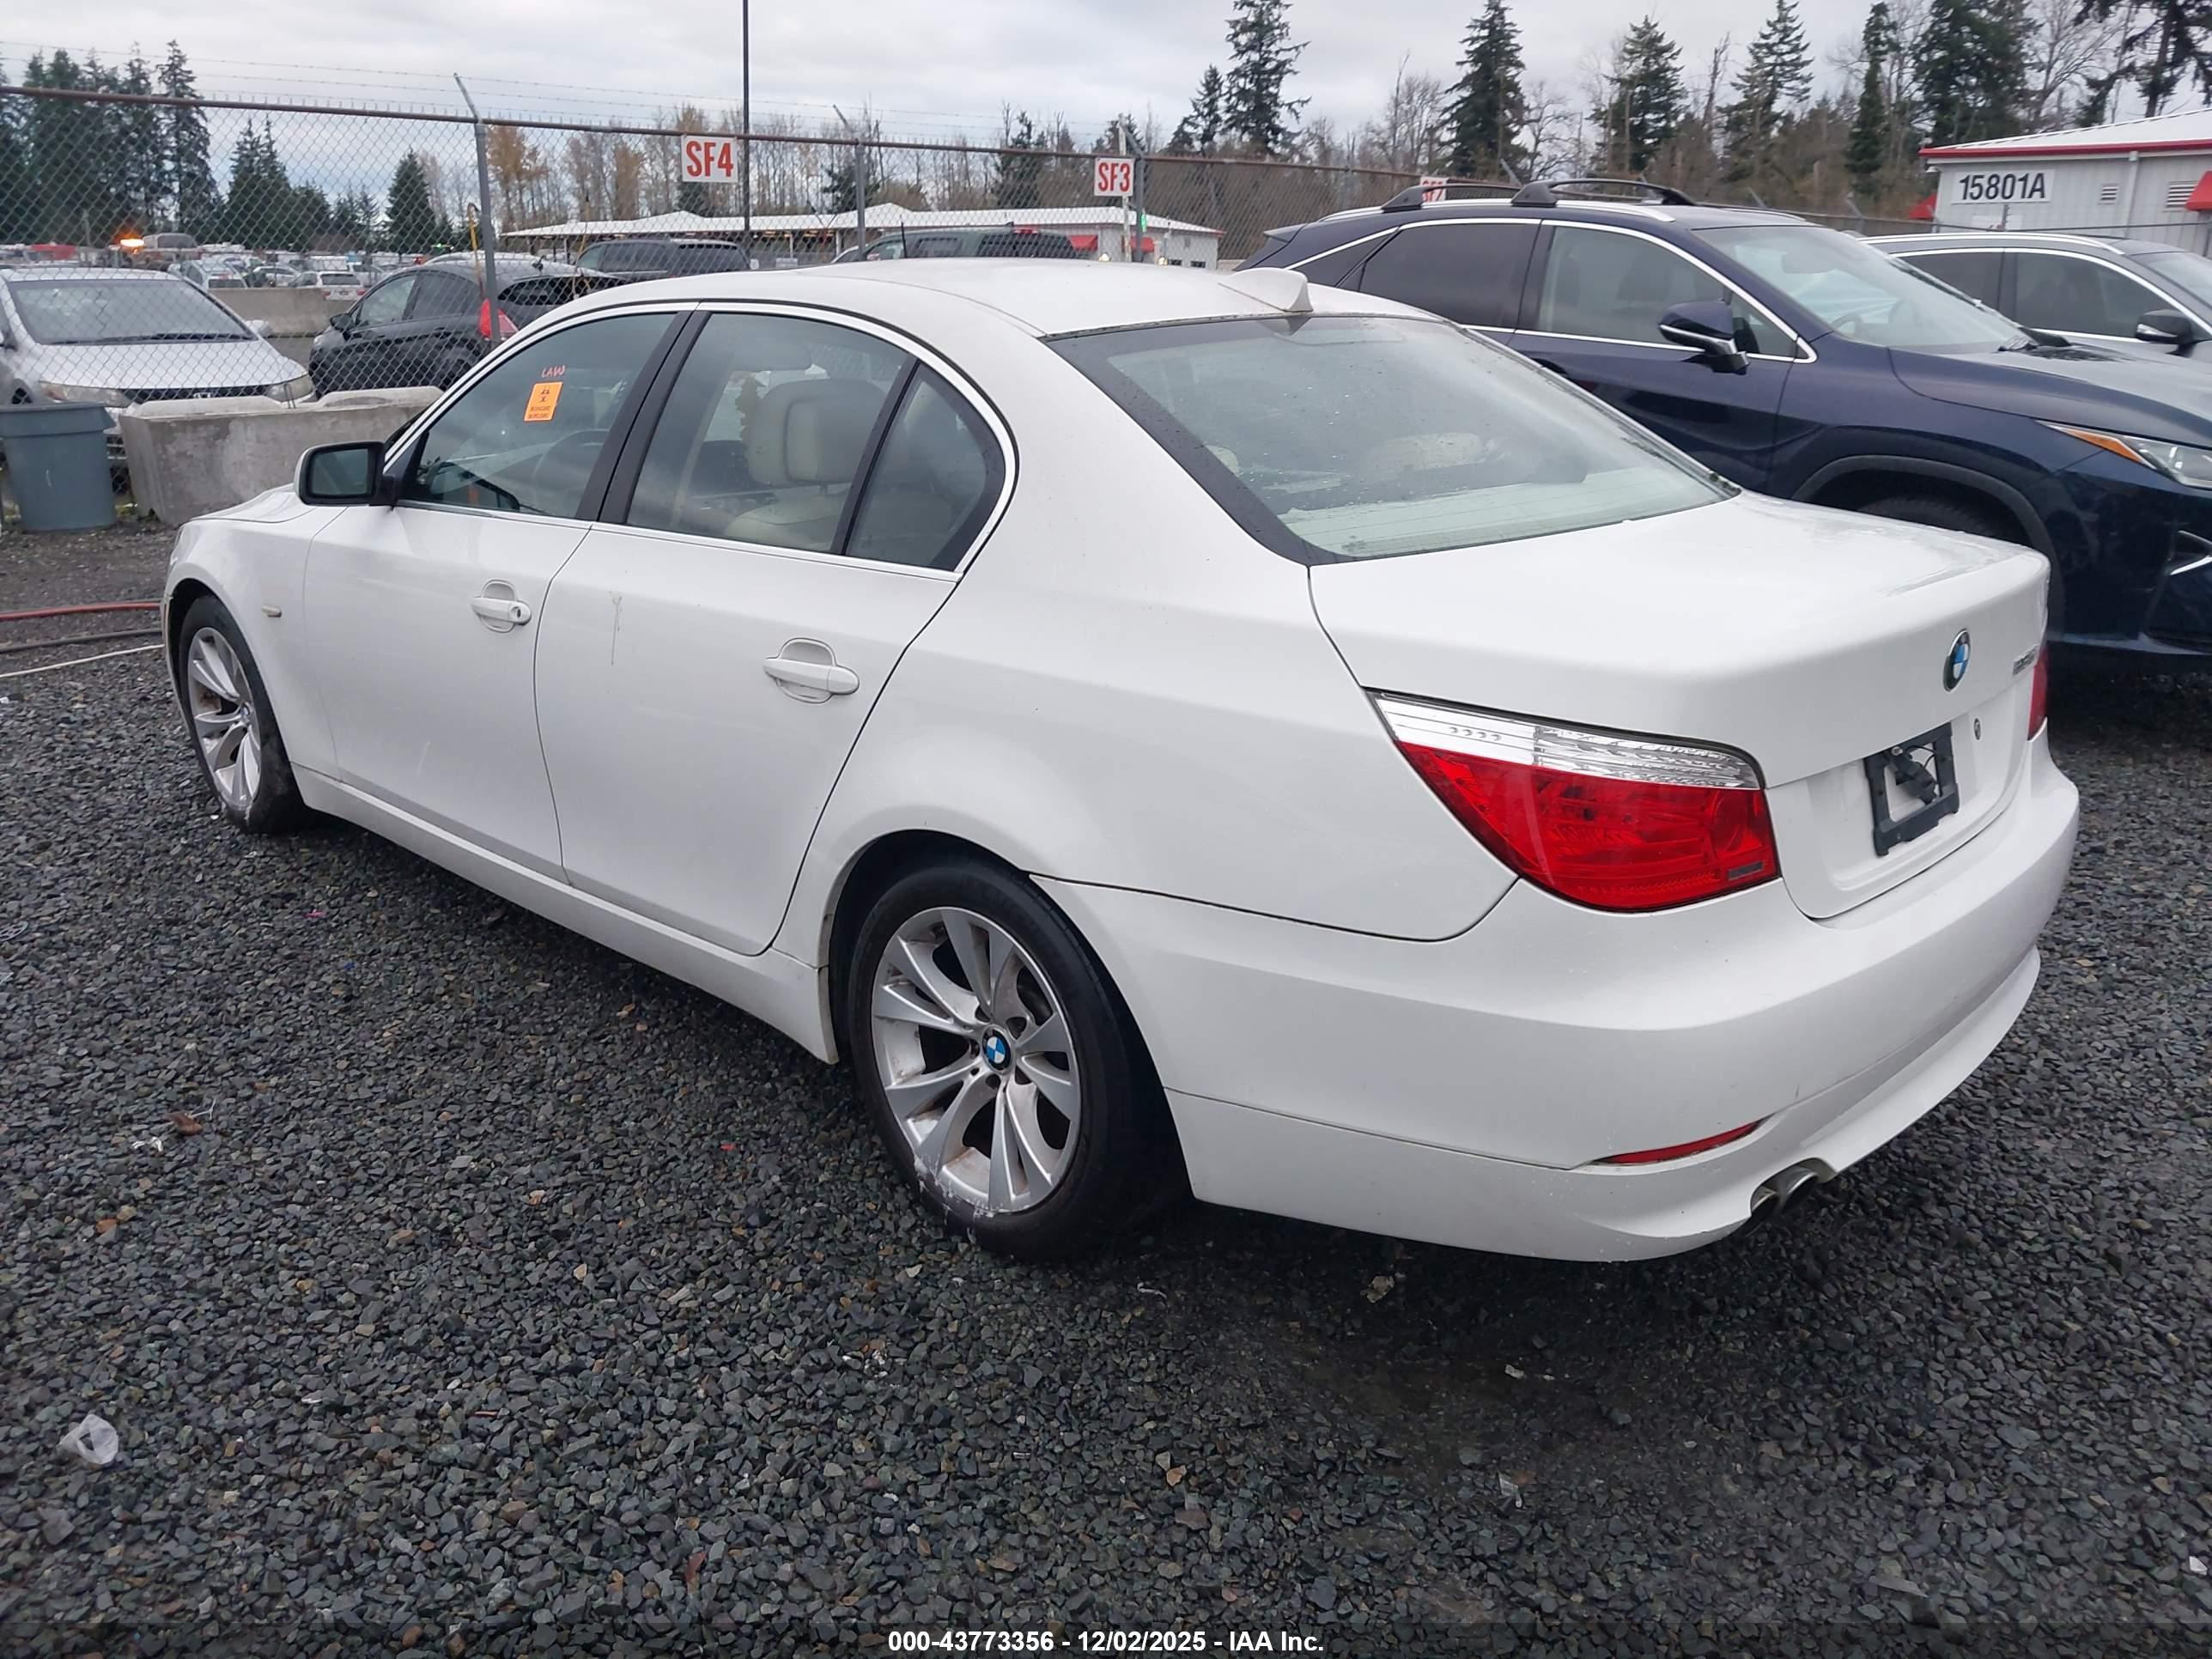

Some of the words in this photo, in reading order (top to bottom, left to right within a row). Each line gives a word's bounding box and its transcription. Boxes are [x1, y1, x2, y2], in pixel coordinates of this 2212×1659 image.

[686, 141, 734, 177] SF4
[1098, 162, 1130, 192] SF3
[1959, 173, 2045, 200] 15801A
